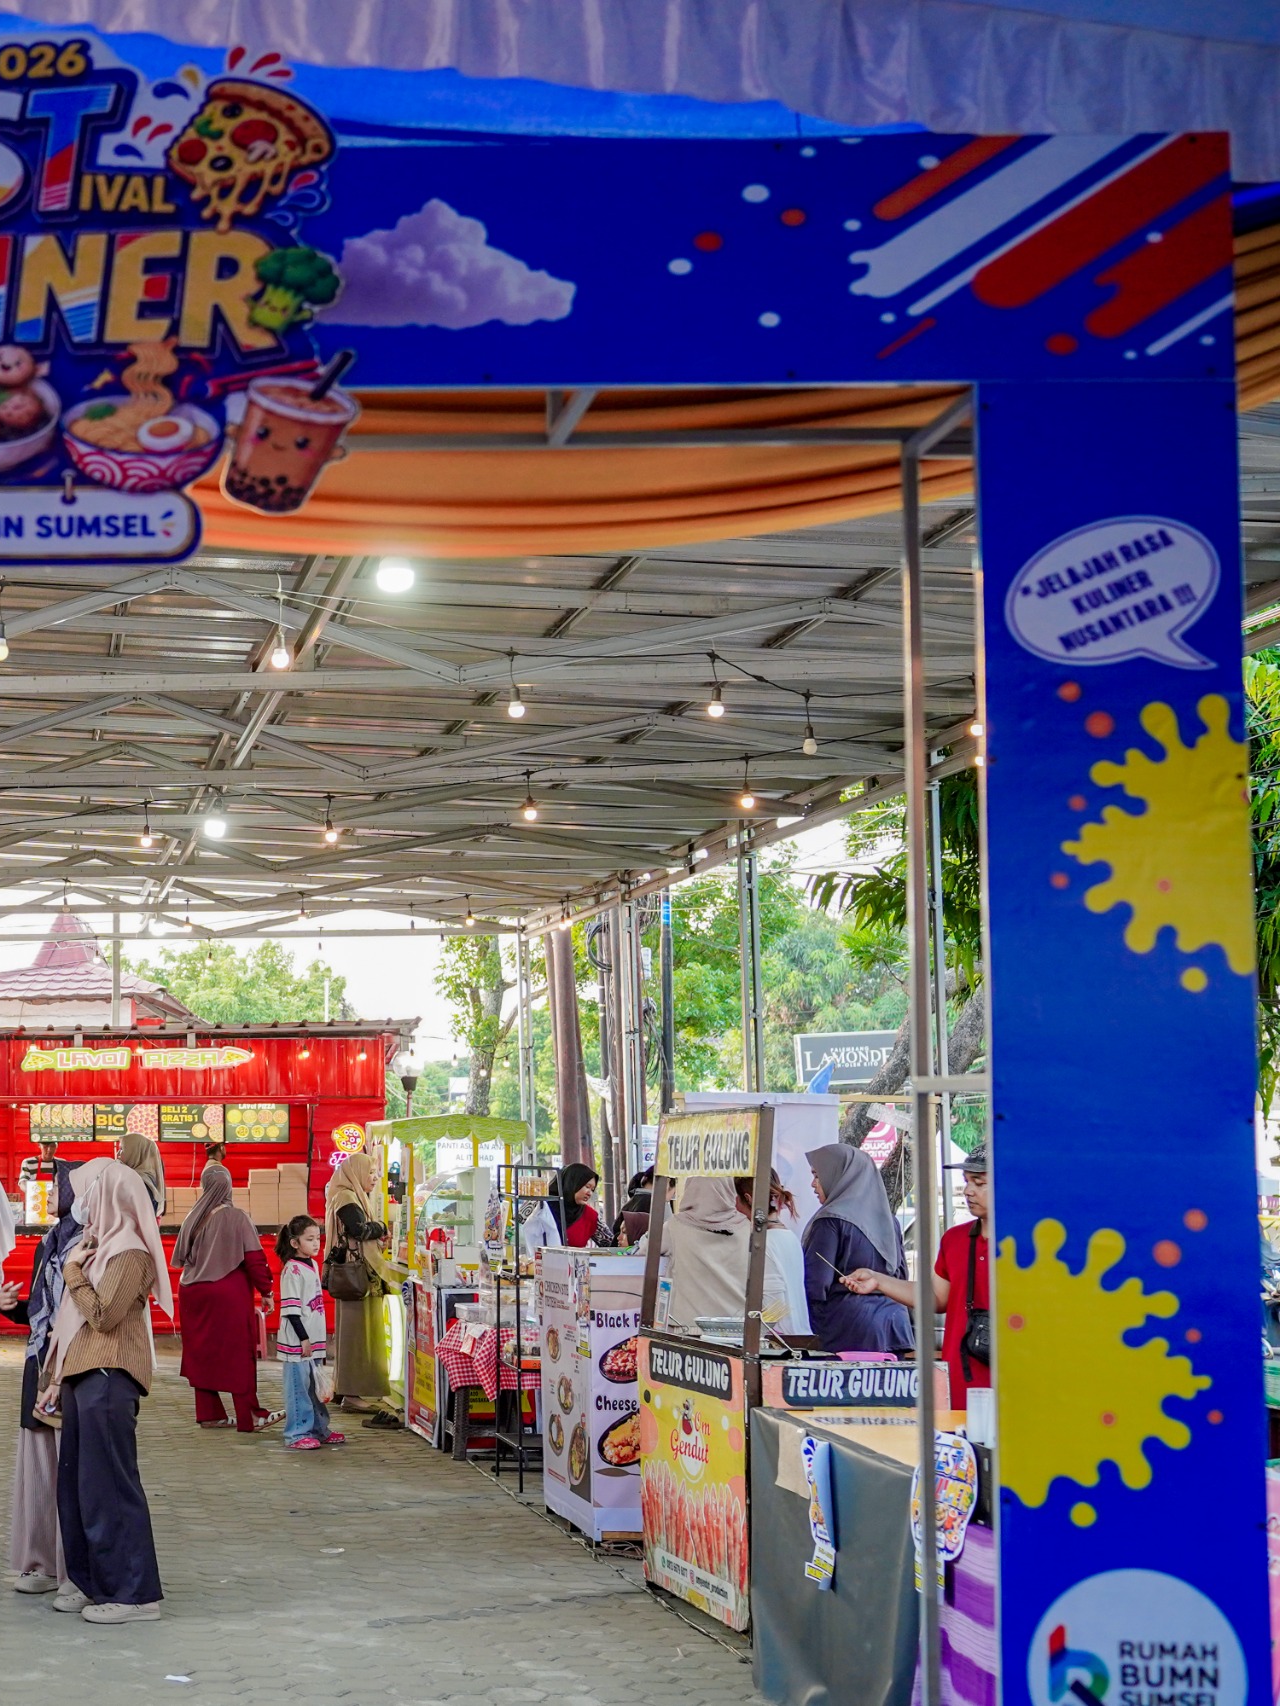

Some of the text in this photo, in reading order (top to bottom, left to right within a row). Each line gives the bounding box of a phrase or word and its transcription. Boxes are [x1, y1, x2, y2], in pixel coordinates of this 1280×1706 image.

[79, 172, 176, 214] IVAL
[35, 514, 157, 539] SUMSEL
[1036, 528, 1175, 599] JELAJAH RASA
[1071, 568, 1154, 616] KULINER
[1058, 594, 1175, 652] NUSANTARA
[57, 1050, 219, 1067] LAVOI PIZZA
[96, 1114, 125, 1126] BIG
[161, 1105, 188, 1113] BELI 2
[161, 1114, 198, 1122] GRATIS 1
[668, 1131, 750, 1171] TELUR GULUNG
[596, 1312, 630, 1328] Black
[651, 1347, 730, 1392] TELUR GULUNG
[788, 1368, 920, 1400] TELUR GULUNG
[595, 1395, 638, 1411] Cheese
[694, 1411, 711, 1436] Om
[670, 1428, 710, 1464] Gendut
[1118, 1640, 1219, 1661] RUMAH
[1120, 1664, 1220, 1689] BUMN
[1118, 1690, 1218, 1706] SUMSEL
